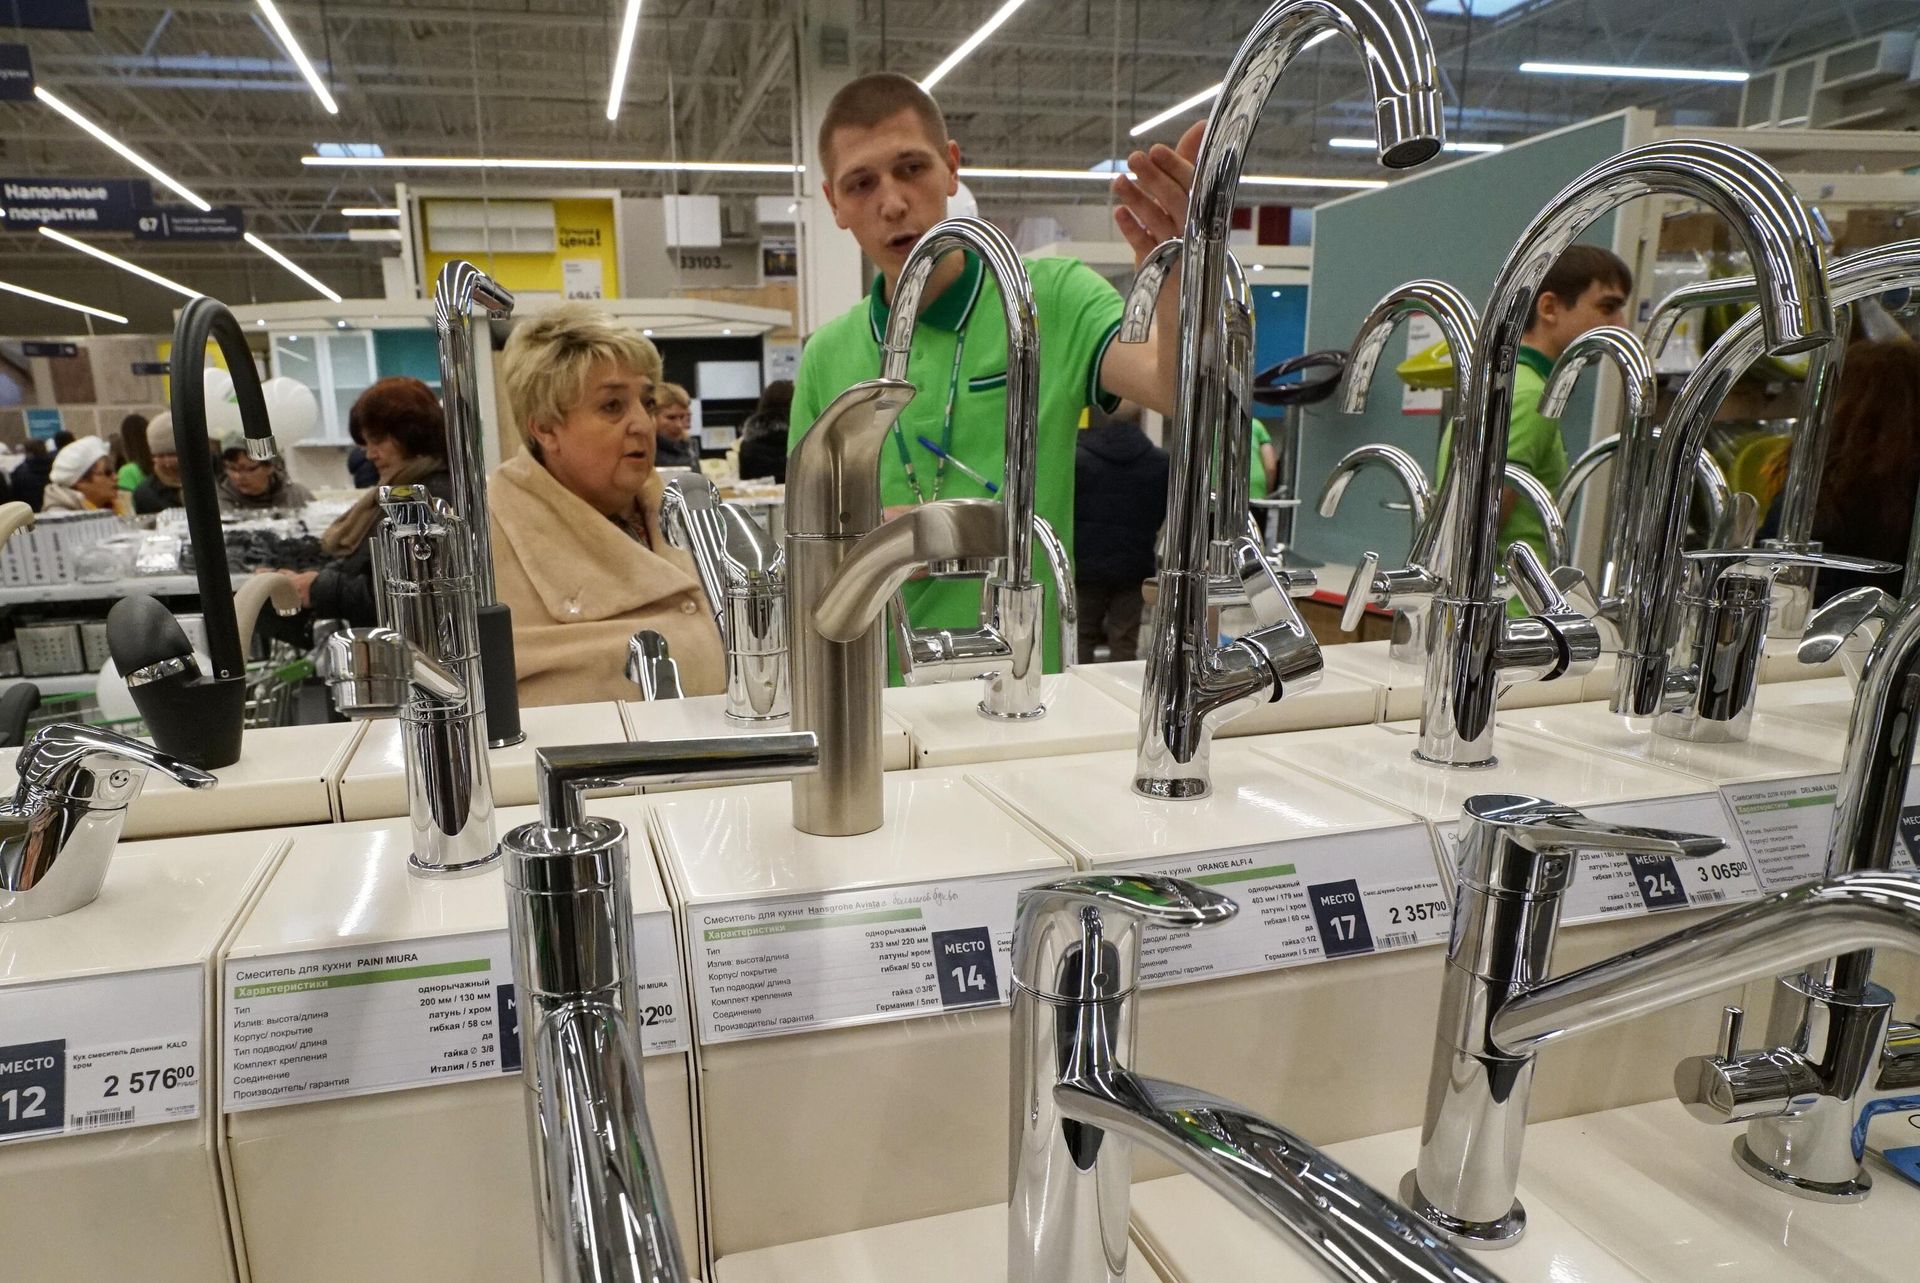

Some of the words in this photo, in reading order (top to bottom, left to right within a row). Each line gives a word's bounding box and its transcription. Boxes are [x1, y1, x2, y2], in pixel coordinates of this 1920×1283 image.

[4, 184, 108, 200] Напольные
[8, 207, 98, 223] покрытия
[139, 217, 158, 232] 67
[560, 229, 601, 248] цена!
[1767, 791, 1779, 799] для
[1613, 861, 1629, 869] хром
[1634, 854, 1666, 865] МЕСТО
[1169, 866, 1192, 878] кухни
[1196, 862, 1230, 873] ORANGE
[1231, 859, 1248, 868] ALFI
[1248, 858, 1254, 866] 4
[1697, 866, 1709, 882] 3
[1592, 873, 1613, 881] гибкая
[1247, 880, 1300, 894] однорычажный
[1643, 873, 1676, 898] 24
[1252, 896, 1264, 905] 403
[1265, 895, 1276, 903] мм
[1280, 892, 1292, 901] 179
[1293, 891, 1304, 899] мм
[1320, 892, 1356, 907] МЕСТО
[703, 912, 756, 926] Смеситель
[758, 911, 776, 921] для
[778, 907, 804, 919] кухни
[808, 901, 854, 915] Hansgrohe
[1261, 904, 1285, 915] латунь
[1288, 903, 1307, 913] хром
[1389, 907, 1402, 925] 2
[1264, 916, 1287, 927] гибкая
[1291, 914, 1300, 922] 60
[1300, 913, 1311, 921] см
[708, 924, 786, 941] Характеристики
[865, 923, 927, 938] однорычажный
[1305, 925, 1314, 934] да
[1330, 914, 1357, 942] 17
[870, 941, 884, 950] 233
[886, 939, 900, 948] мм/
[901, 937, 915, 946] 220
[917, 936, 929, 944] мм
[1169, 931, 1191, 942] длина
[1281, 938, 1301, 948] гайка
[1307, 935, 1317, 943] 1/2
[706, 948, 721, 957] Тип
[879, 950, 909, 962] латунь/
[910, 949, 931, 960] хром
[944, 940, 986, 956] МЕСТО
[1157, 943, 1193, 955] крепления
[1264, 950, 1298, 962] Германия
[1302, 948, 1307, 956] 5
[1308, 946, 1321, 956] лет
[236, 967, 296, 981] Смеситель
[299, 964, 319, 975] для
[322, 960, 352, 973] кухни
[357, 957, 384, 968] PAINI
[385, 953, 418, 965] MIURA
[707, 959, 734, 969] Излив:
[736, 953, 790, 966] высота/длина
[880, 963, 910, 974] гибкая/
[911, 962, 921, 970] 50
[922, 961, 933, 969] см
[708, 971, 739, 982] Корпус/
[740, 967, 778, 979] покрытие
[925, 972, 935, 982] да
[1184, 963, 1214, 976] гарантия
[647, 981, 668, 990] MIURA
[710, 985, 725, 994] Тип
[726, 980, 766, 993] подводки/
[767, 977, 792, 988] длина
[951, 964, 987, 993] 14
[239, 979, 329, 998] Характеристики
[418, 978, 491, 995] однорычажный
[891, 986, 914, 998] гайка
[420, 997, 436, 1007] 200
[437, 996, 452, 1005] мм
[459, 994, 475, 1003] 130
[477, 993, 491, 1001] мм
[711, 994, 749, 1007] Комплект
[751, 990, 793, 1003] крепления
[234, 1006, 251, 1016] Тип
[428, 1010, 461, 1021] латунь
[468, 1006, 492, 1018] хром
[712, 1007, 762, 1020] Соединение
[876, 1001, 915, 1013] Германия
[234, 1019, 264, 1029] Излив:
[267, 1011, 329, 1026] высота/длина
[429, 1021, 461, 1034] гибкая
[467, 1020, 478, 1029] 58
[479, 1018, 493, 1027] см
[714, 1018, 778, 1033] Производитель/
[779, 1013, 815, 1026] гарантия
[234, 1031, 268, 1043] Корпус/
[270, 1026, 313, 1039] покрытие
[482, 1031, 494, 1042] да
[73, 1054, 86, 1062] Кух
[88, 1049, 129, 1061] смеситель
[166, 1040, 188, 1050] KALO
[234, 1048, 250, 1057] Тип
[252, 1041, 297, 1054] подводки/
[299, 1039, 328, 1049] длина
[443, 1048, 469, 1059] гайка
[481, 1044, 495, 1055] 3/8
[0, 1056, 55, 1075] МЕСТО
[73, 1062, 93, 1071] хром
[234, 1058, 277, 1071] Комплект
[279, 1052, 328, 1065] крепления
[430, 1062, 465, 1075] Италия
[471, 1060, 478, 1068] 5
[479, 1058, 495, 1068] лет
[233, 1071, 290, 1085] Соединение
[103, 1075, 119, 1098] 2
[233, 1082, 308, 1100] Производитель/
[309, 1077, 350, 1090] гарантия
[1, 1086, 47, 1122] 12
